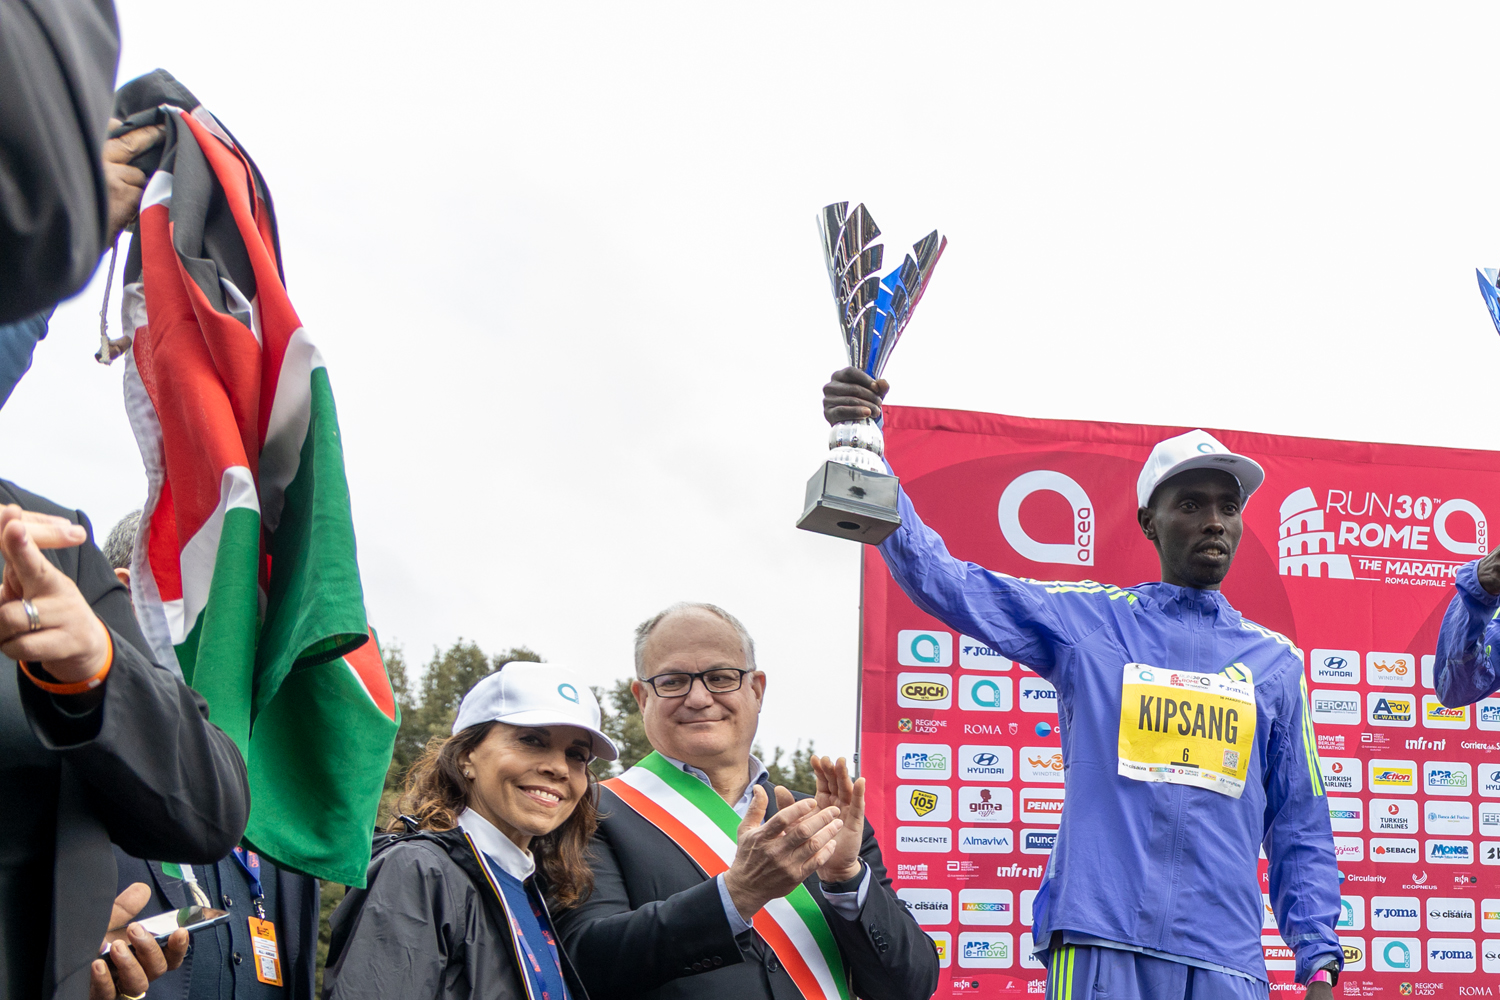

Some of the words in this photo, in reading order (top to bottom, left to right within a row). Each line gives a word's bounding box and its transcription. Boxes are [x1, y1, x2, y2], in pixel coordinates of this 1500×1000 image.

[1326, 489, 1393, 517] RUN
[1077, 507, 1091, 562] acea
[1338, 521, 1430, 550] ROME
[1477, 520, 1486, 554] acea
[1358, 559, 1382, 571] THE
[1385, 577, 1409, 585] ROMA
[1410, 579, 1446, 587] CAPITALE
[905, 686, 944, 697] CRICH
[1315, 700, 1357, 711] FERCAM
[915, 719, 947, 727] REGIONE
[1138, 694, 1239, 745] KIPSANG
[964, 725, 1002, 734] ROMA
[1461, 741, 1487, 749] Corriere
[1182, 748, 1190, 762] 6
[904, 761, 944, 769] e-move
[967, 767, 1005, 775] HYUNDAI
[1381, 771, 1411, 781] Action
[913, 796, 934, 810] 105
[969, 802, 1003, 813] gima
[901, 836, 948, 844] RINASCENTE
[1431, 844, 1469, 856] MONGE
[1347, 874, 1386, 884] Circularity
[1383, 908, 1418, 918] Joma
[966, 949, 1006, 957] e-move
[1440, 950, 1473, 960] Joma
[1459, 986, 1493, 996] ROMA
